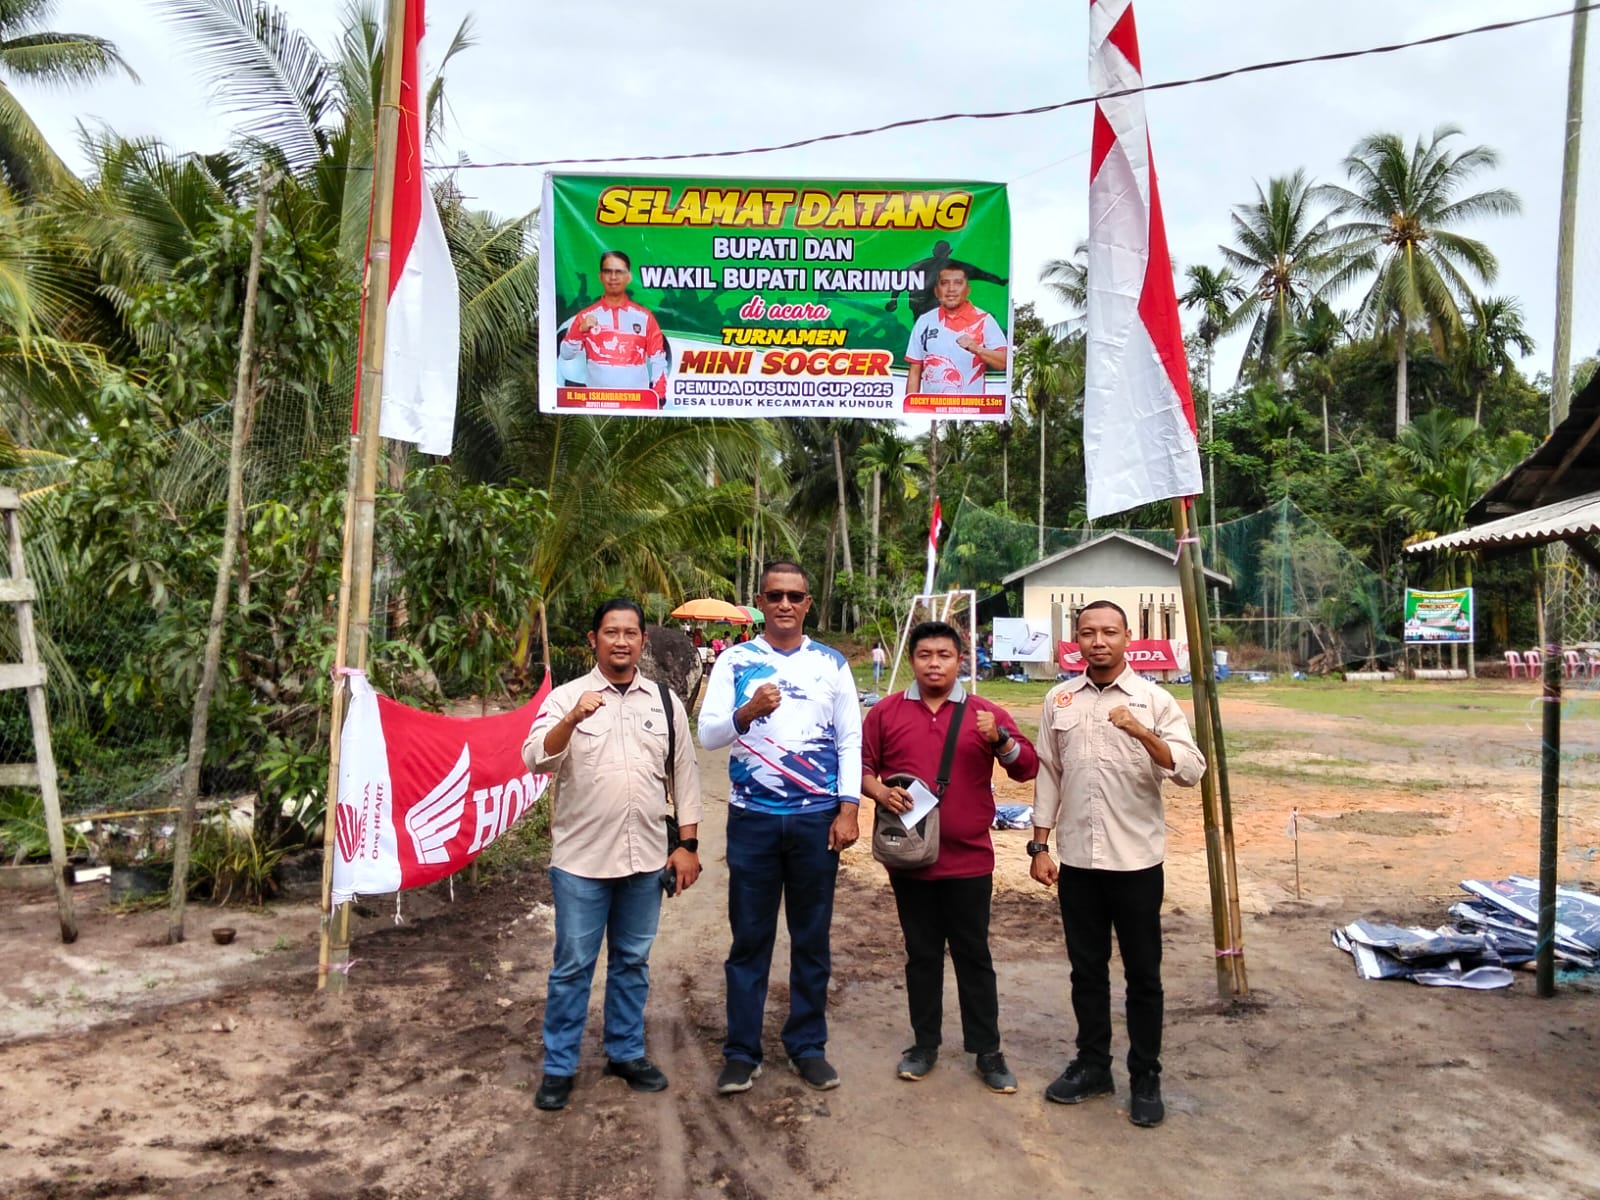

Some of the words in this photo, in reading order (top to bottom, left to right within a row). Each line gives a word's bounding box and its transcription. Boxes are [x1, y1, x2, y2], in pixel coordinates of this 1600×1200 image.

[598, 188, 794, 226] SELAMAT
[797, 191, 971, 229] DATANG
[713, 236, 797, 260] BUPATI
[803, 238, 854, 260] DAN
[640, 267, 717, 289] WAKIL
[723, 268, 806, 290] BUPATI
[813, 269, 925, 291] KARIMUN
[740, 296, 764, 319] di
[767, 303, 830, 320] acara
[721, 327, 847, 346] TURNAMEN
[678, 350, 754, 375] MINI
[760, 350, 891, 377] SOCCER
[674, 381, 741, 396] PEMUDA
[743, 381, 800, 396] DUSUN
[802, 382, 815, 396] II
[817, 383, 852, 396] CUP
[853, 383, 893, 397] 2025
[674, 397, 707, 406] DESA
[710, 398, 753, 407] LUBUK
[757, 399, 835, 408] KECAMATAN
[839, 399, 893, 408] KUNDUR
[1124, 650, 1168, 662] NDA
[360, 780, 371, 860] HONDA
[467, 771, 549, 855] HON
[371, 832, 380, 860] One
